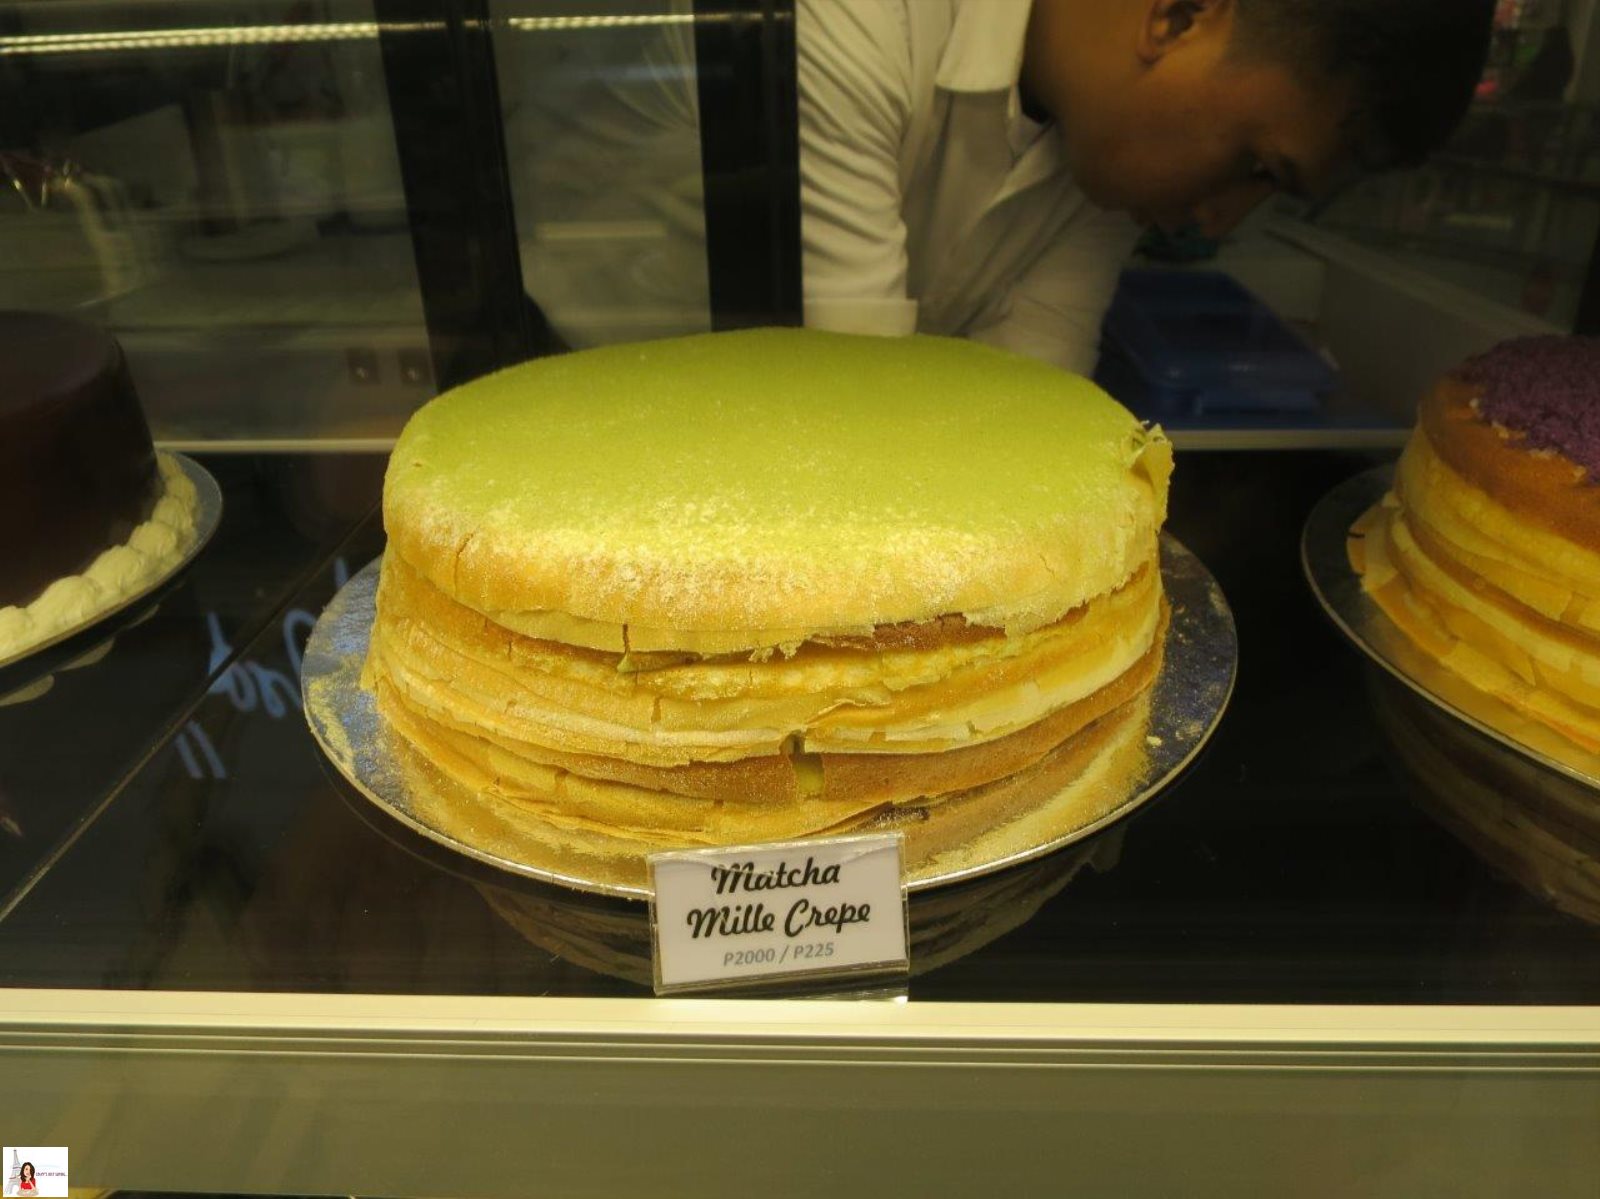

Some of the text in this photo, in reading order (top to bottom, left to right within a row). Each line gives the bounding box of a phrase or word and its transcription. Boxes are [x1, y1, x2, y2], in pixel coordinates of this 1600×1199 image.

[712, 857, 840, 894] Matcha
[686, 898, 871, 938] Mille Crepe
[723, 948, 775, 966] P2000
[793, 943, 834, 960] P225
